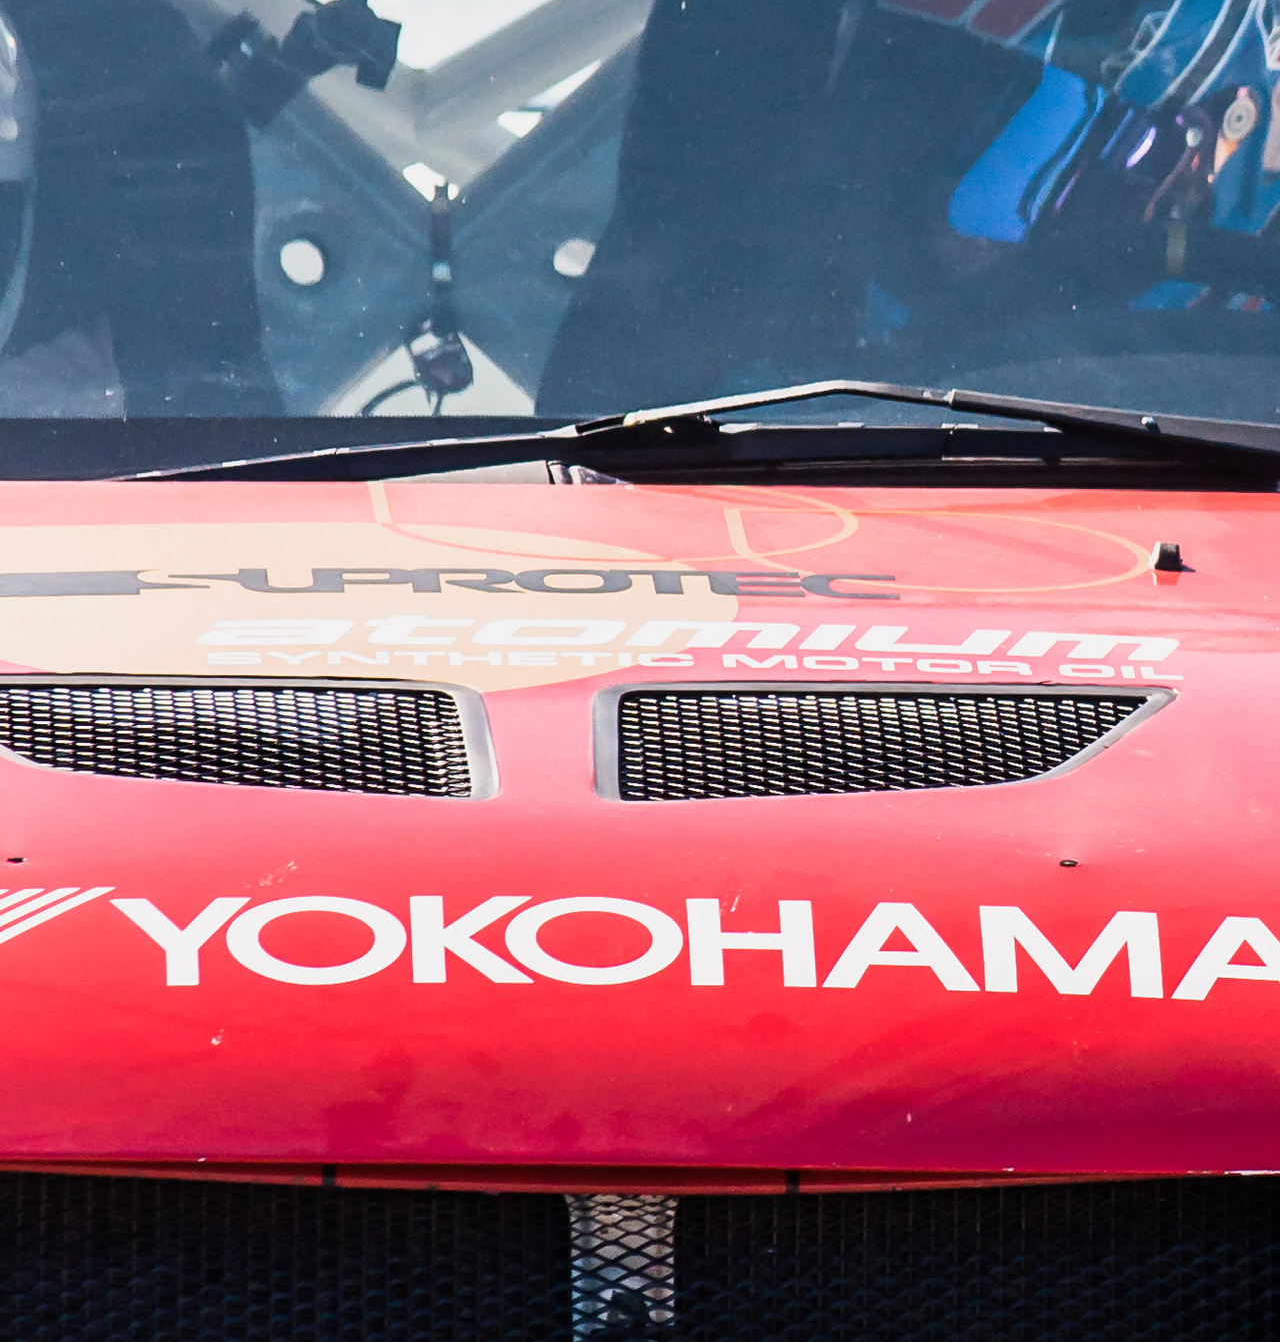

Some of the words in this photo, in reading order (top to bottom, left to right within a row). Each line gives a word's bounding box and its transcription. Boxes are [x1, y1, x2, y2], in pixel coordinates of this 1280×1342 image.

[205, 650, 694, 667] SYNTHETIC
[722, 653, 1033, 676] MOTOR
[1058, 665, 1184, 681] OIL
